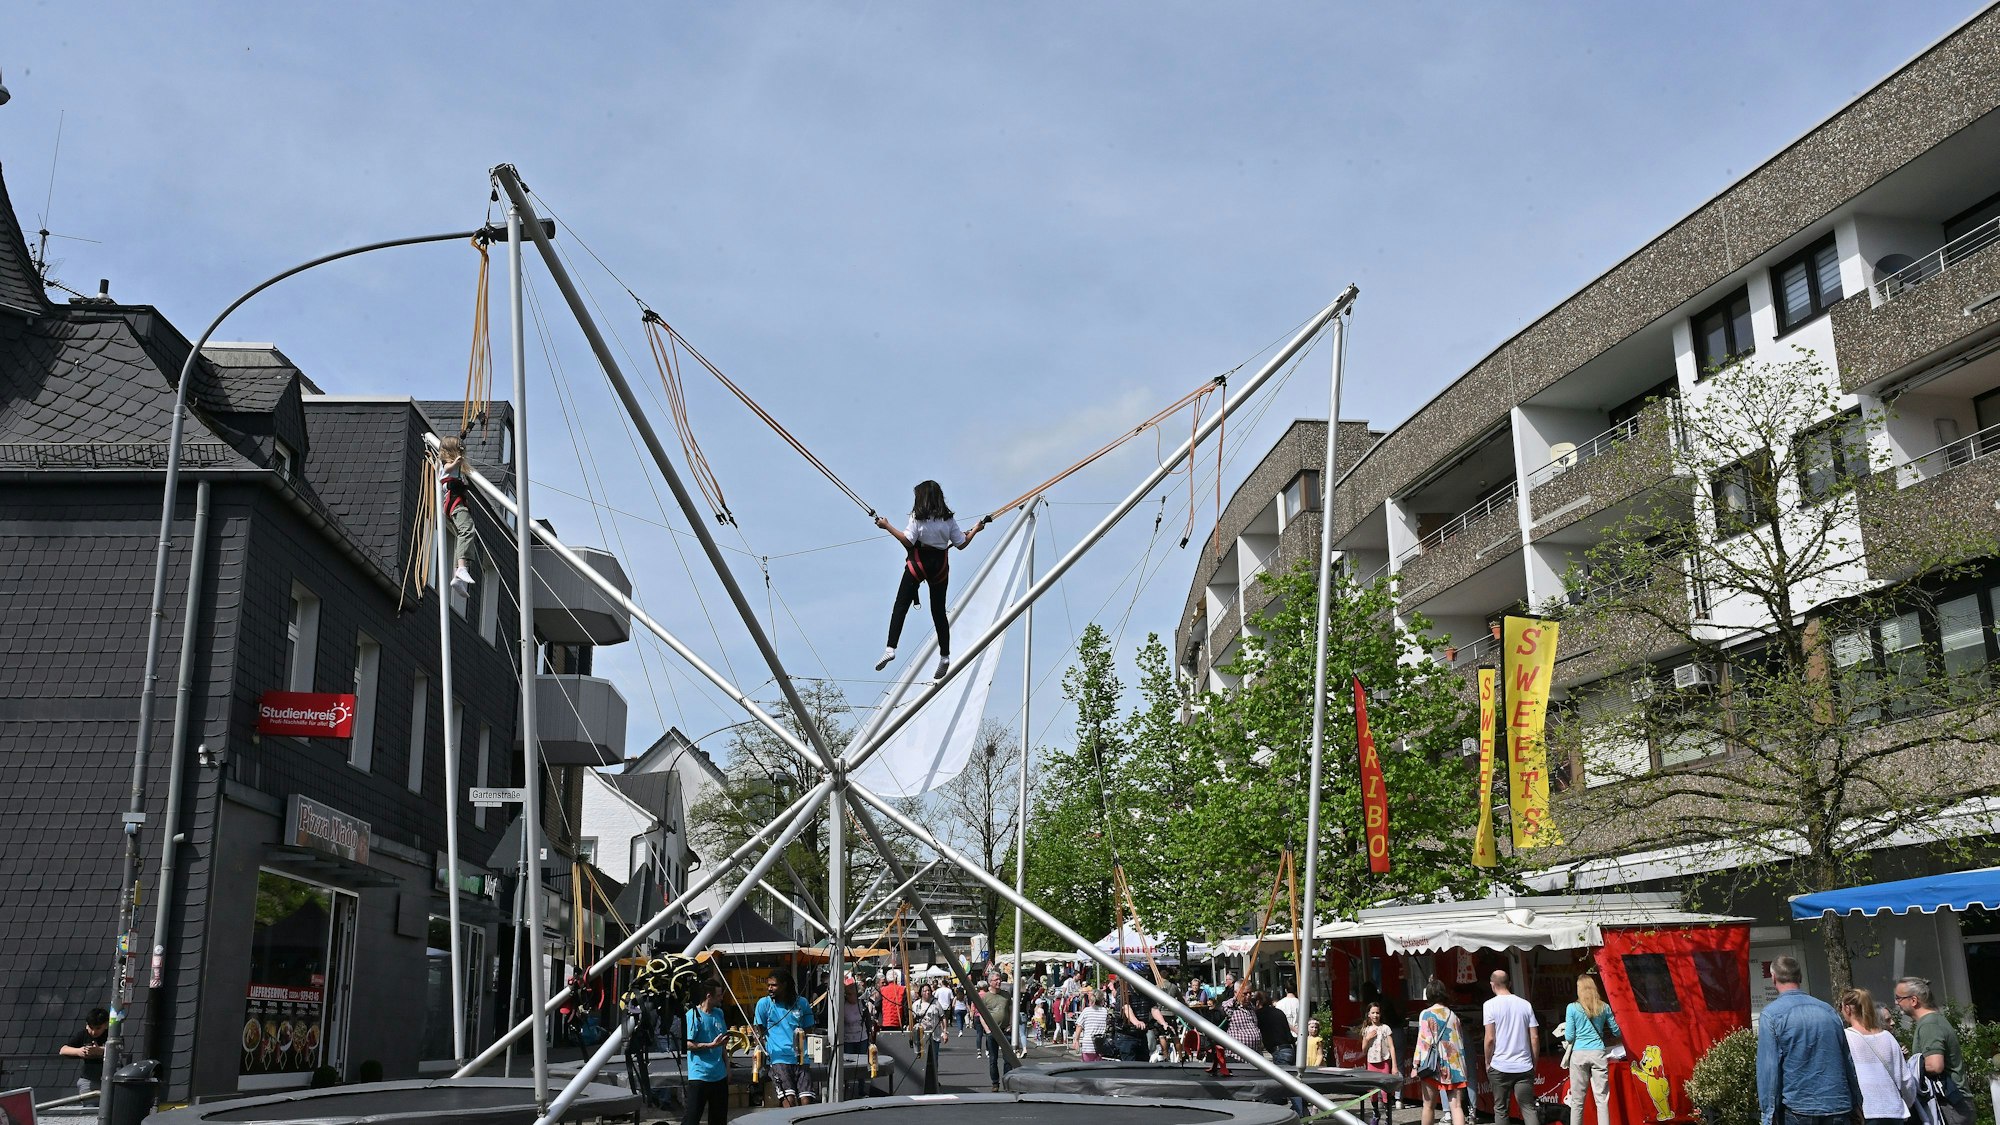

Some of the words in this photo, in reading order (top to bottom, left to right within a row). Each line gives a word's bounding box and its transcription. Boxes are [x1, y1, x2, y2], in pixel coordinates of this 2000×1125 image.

[261, 705, 336, 722] Studienkreis
[1513, 627, 1542, 837] SWEETS
[472, 789, 521, 800] Gartenstraße
[299, 802, 331, 841] Pizza
[330, 816, 359, 850] Mado
[250, 986, 288, 999] LIEFERSERVICE
